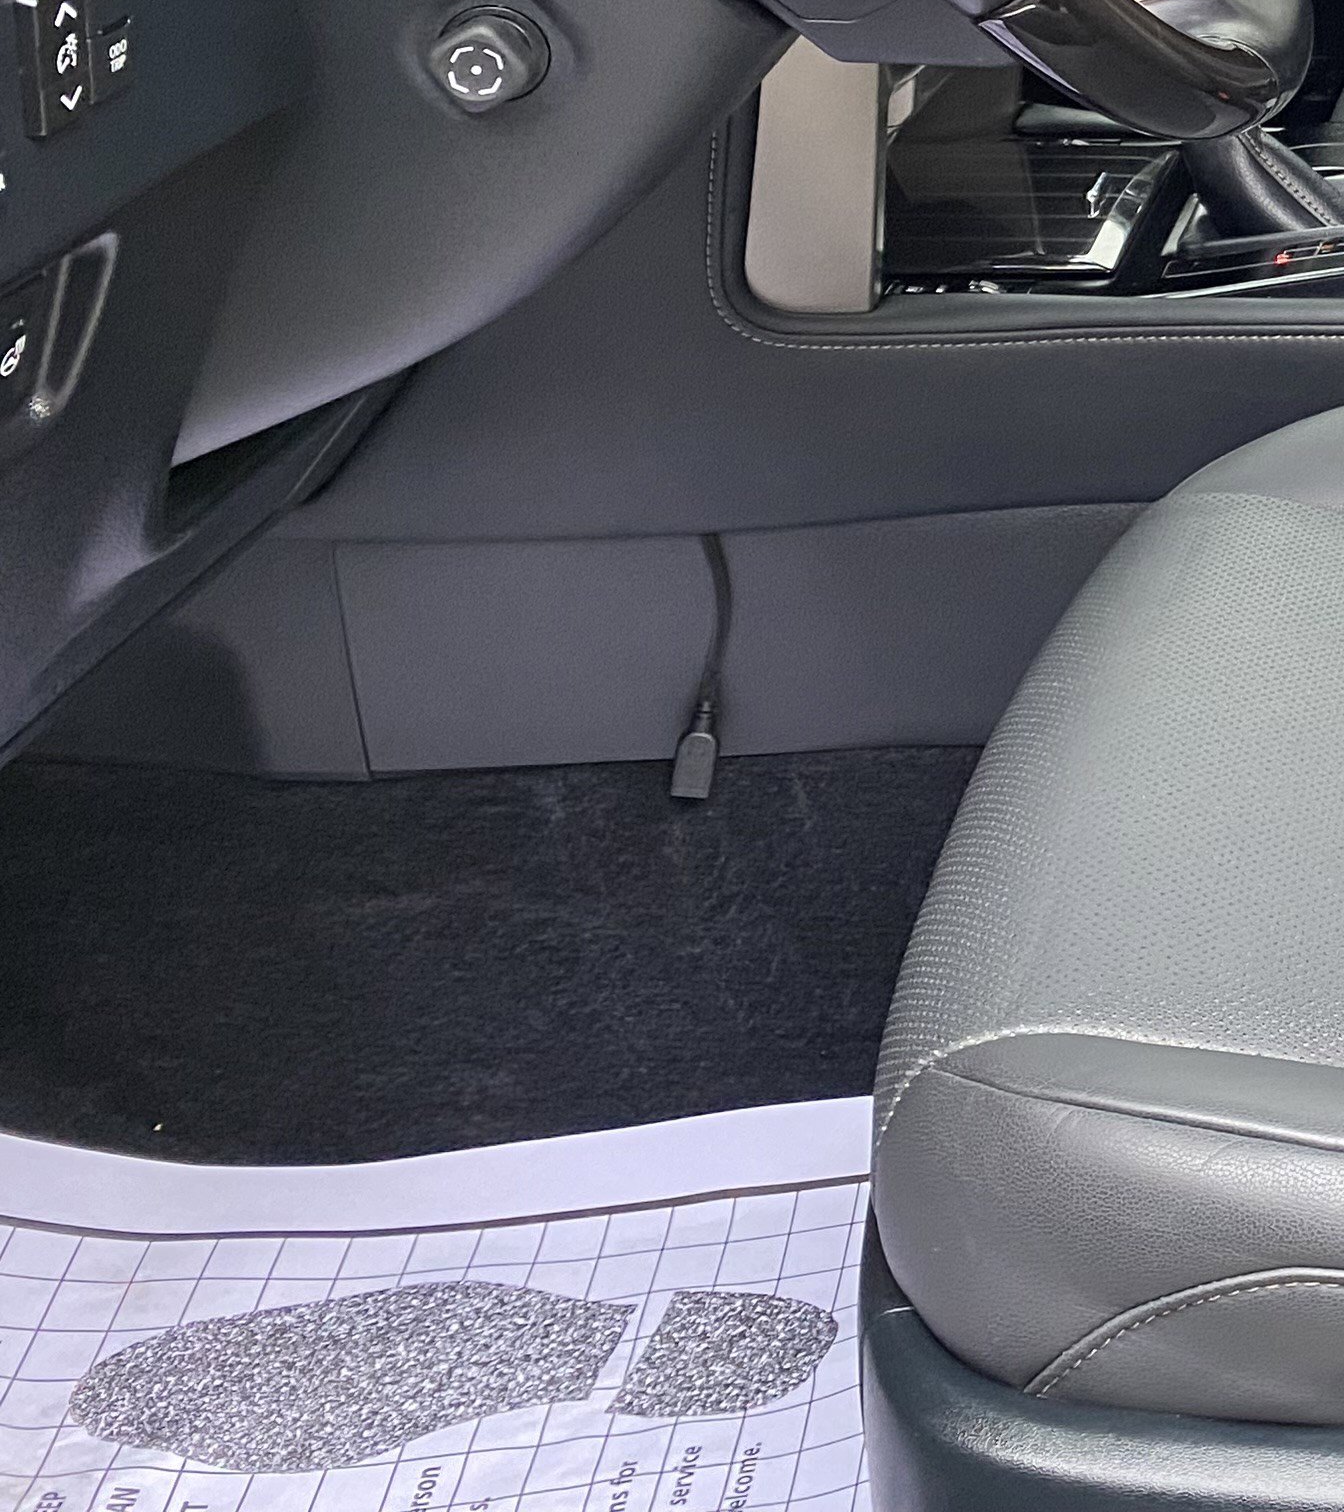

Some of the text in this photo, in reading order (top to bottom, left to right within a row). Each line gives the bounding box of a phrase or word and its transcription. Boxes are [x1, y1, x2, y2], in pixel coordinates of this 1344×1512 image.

[610, 1460, 638, 1486] for
[670, 1445, 703, 1506] service
[730, 1441, 762, 1512] elcome.
